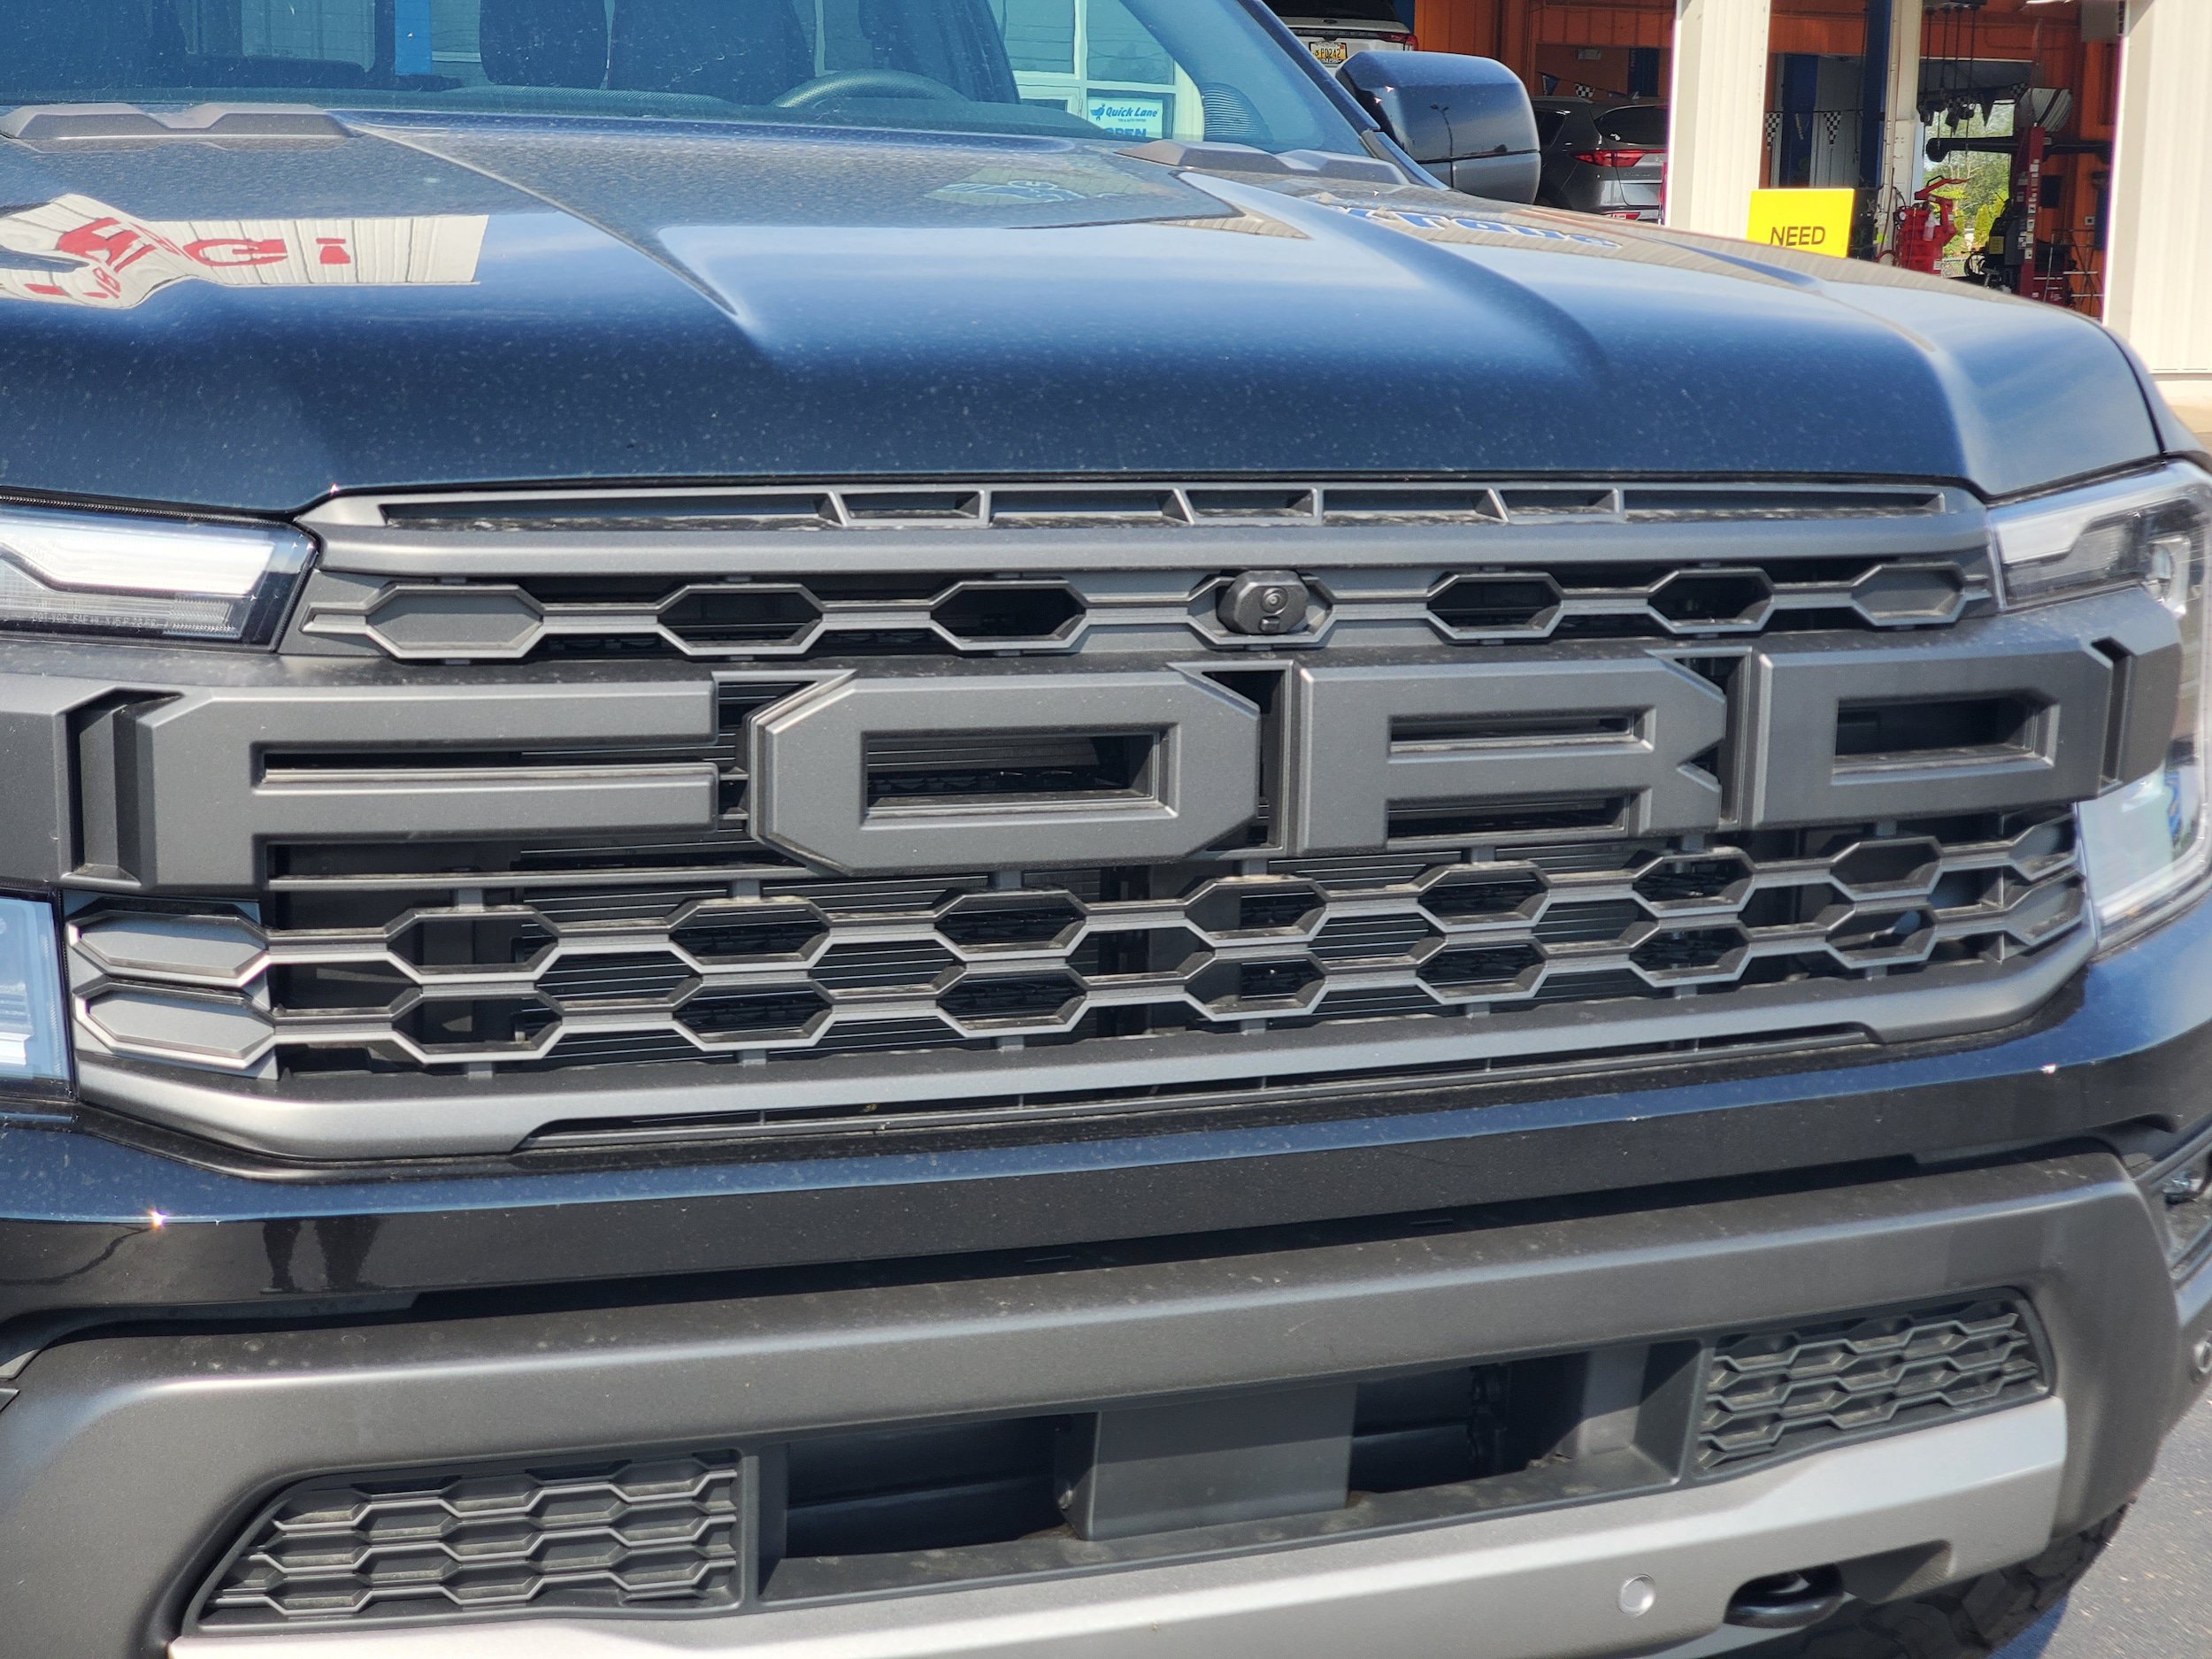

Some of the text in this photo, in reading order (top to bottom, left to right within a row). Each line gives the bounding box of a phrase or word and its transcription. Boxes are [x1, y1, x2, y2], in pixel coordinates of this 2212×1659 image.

[1106, 107, 1158, 117] Quick Lane
[1770, 226, 1826, 247] NEED
[134, 634, 2113, 894] FORD
